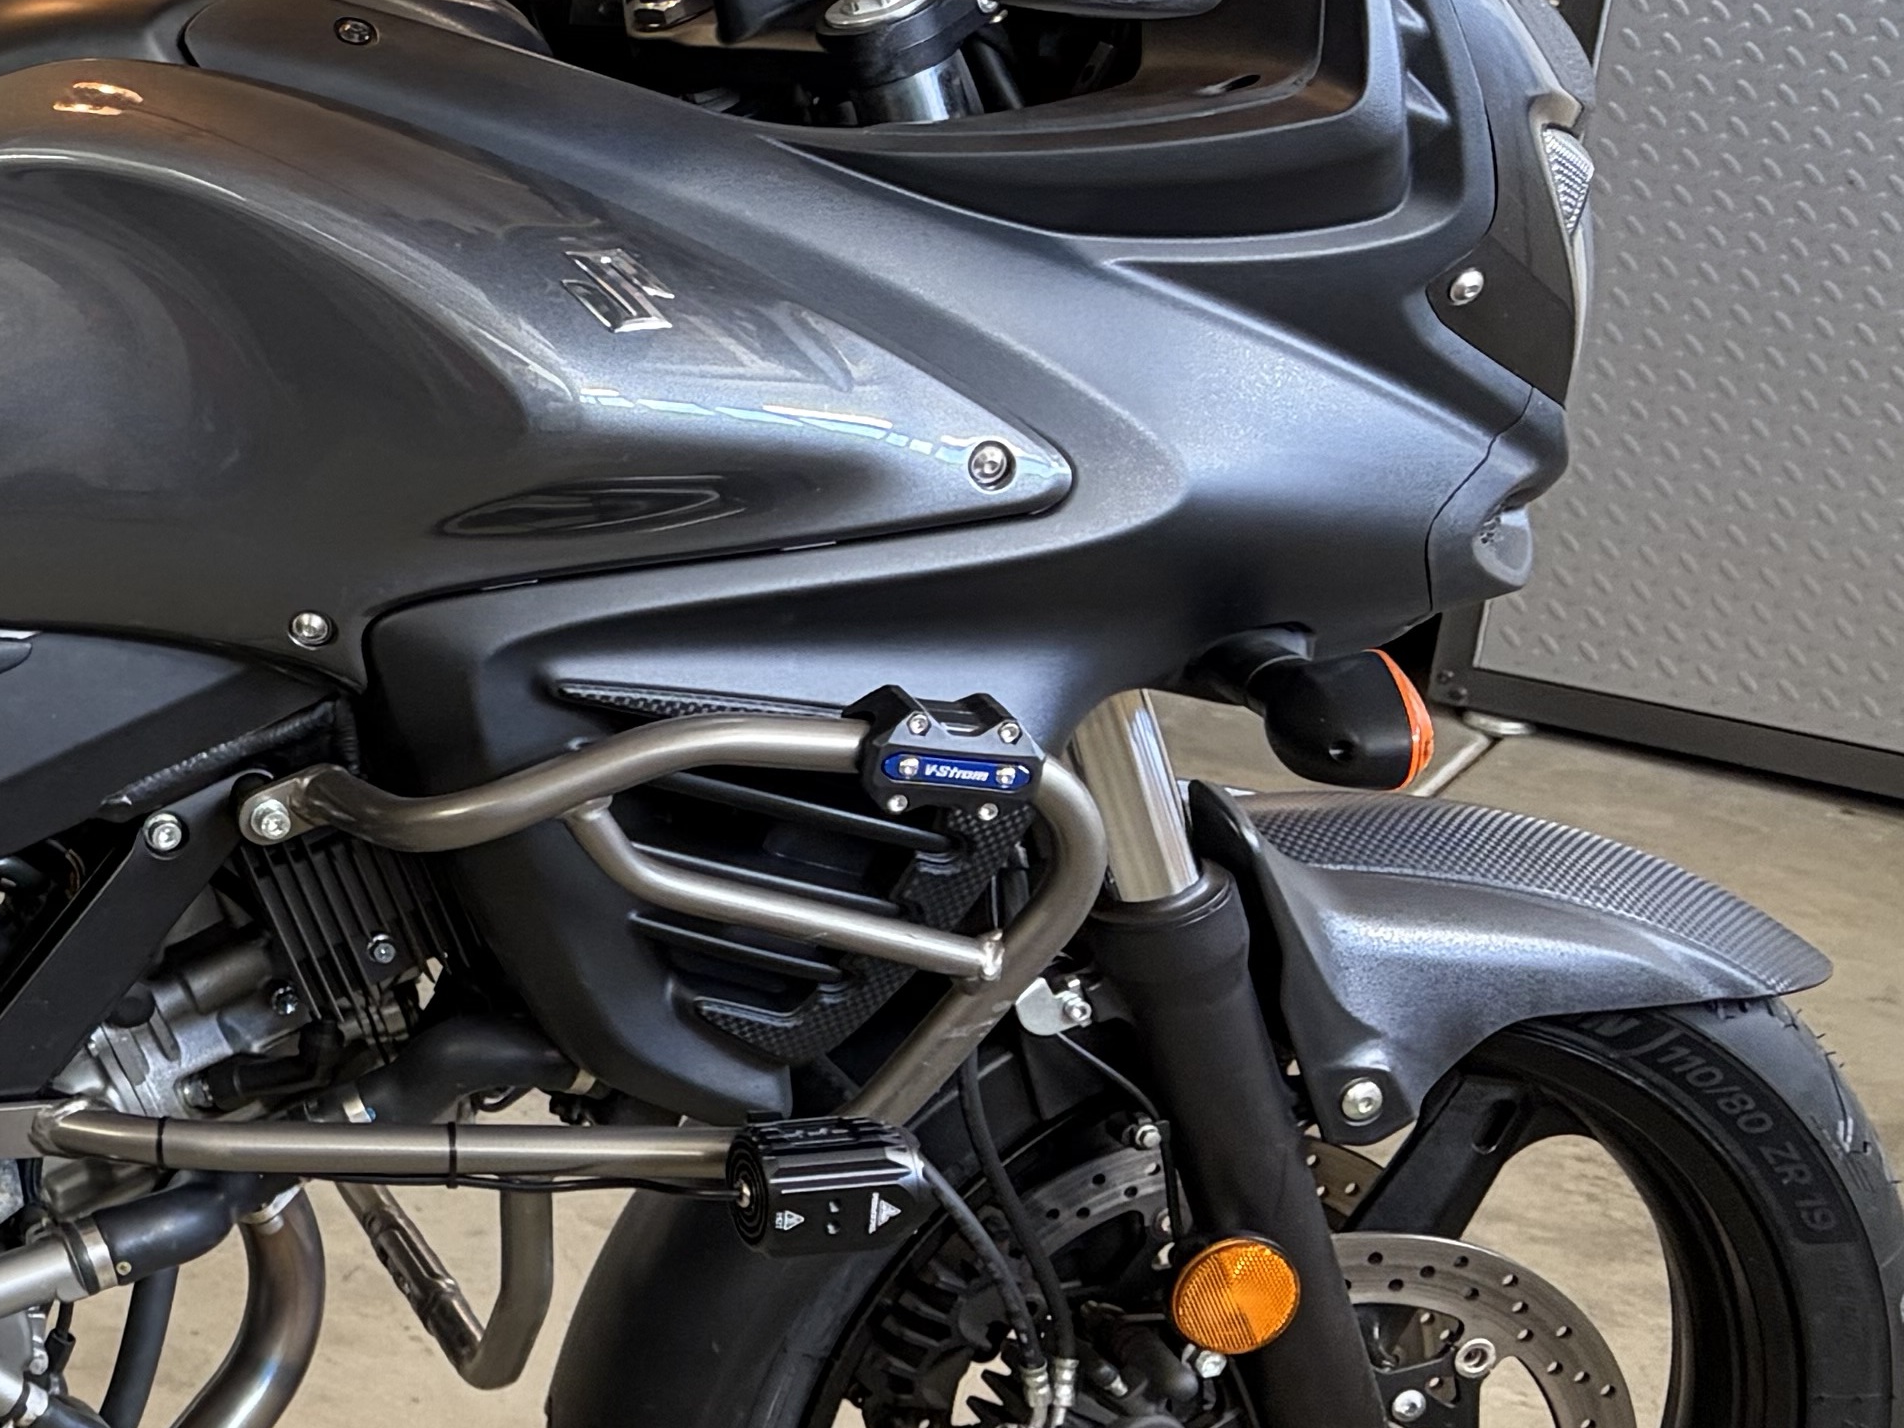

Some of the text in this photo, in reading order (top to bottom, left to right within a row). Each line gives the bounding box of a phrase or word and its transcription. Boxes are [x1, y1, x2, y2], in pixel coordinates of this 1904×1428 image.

[924, 763, 989, 782] V-Strom
[1656, 1045, 1837, 1232] 110/80 ZR 19
